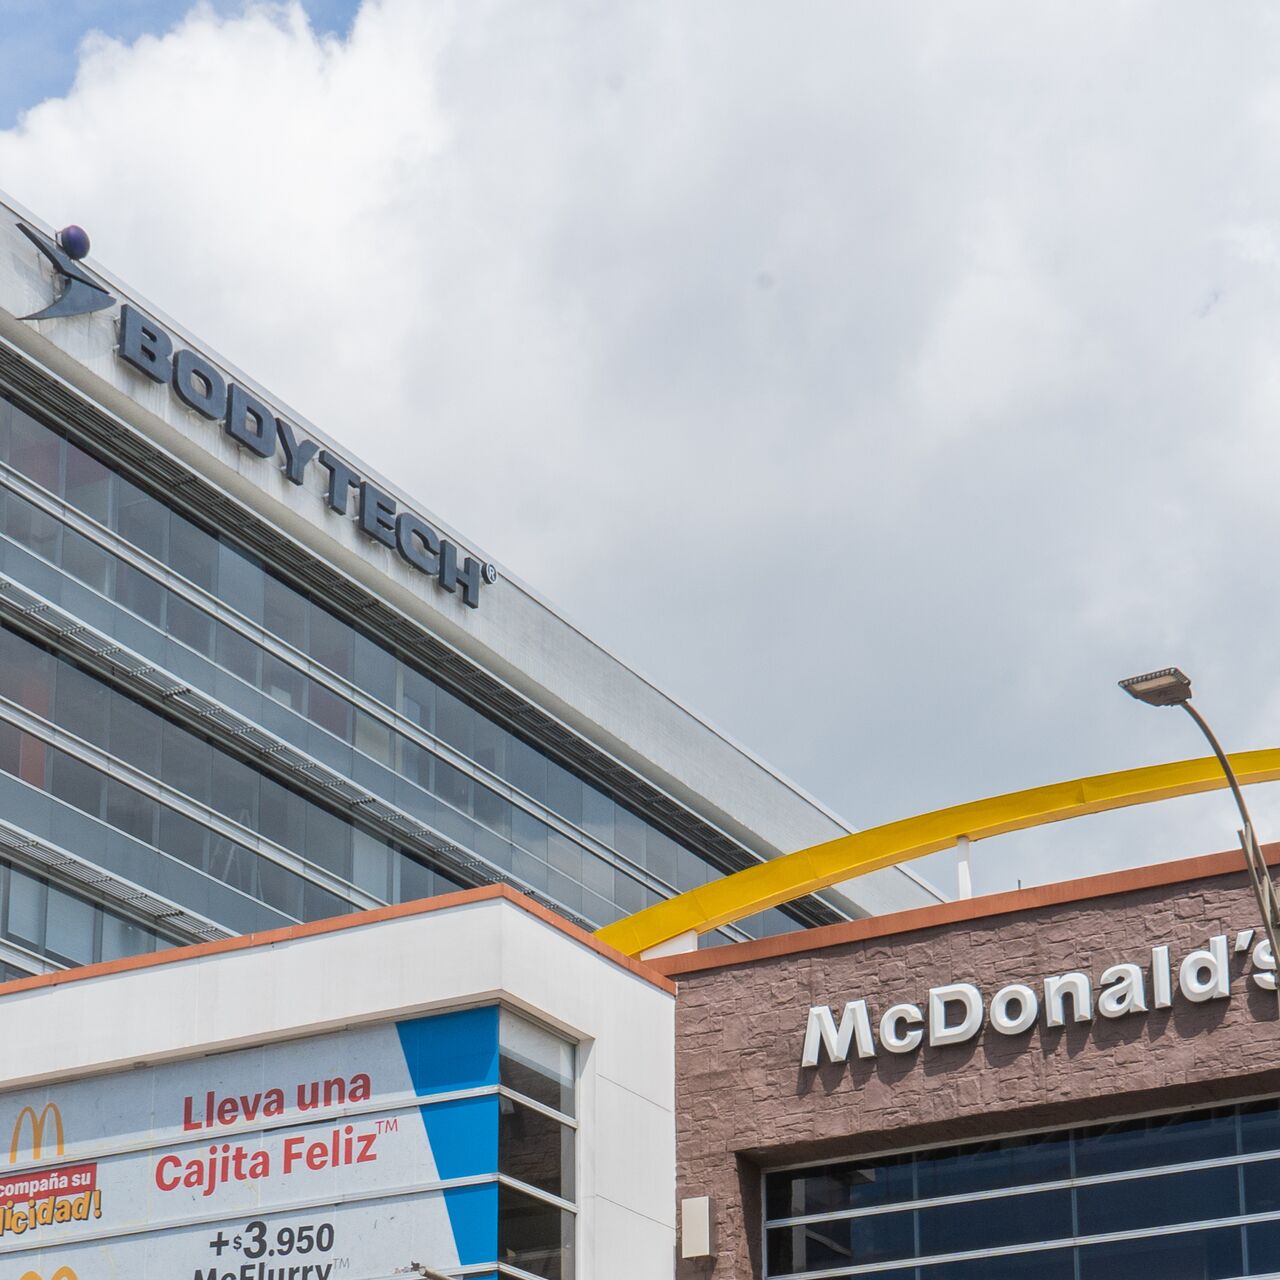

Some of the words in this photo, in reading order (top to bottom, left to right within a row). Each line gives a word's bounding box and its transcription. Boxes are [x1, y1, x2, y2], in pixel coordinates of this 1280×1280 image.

[183, 1087, 285, 1131] Lleva
[296, 1072, 371, 1112] una
[71, 1172, 91, 1187] su
[155, 1143, 270, 1197] Cajita
